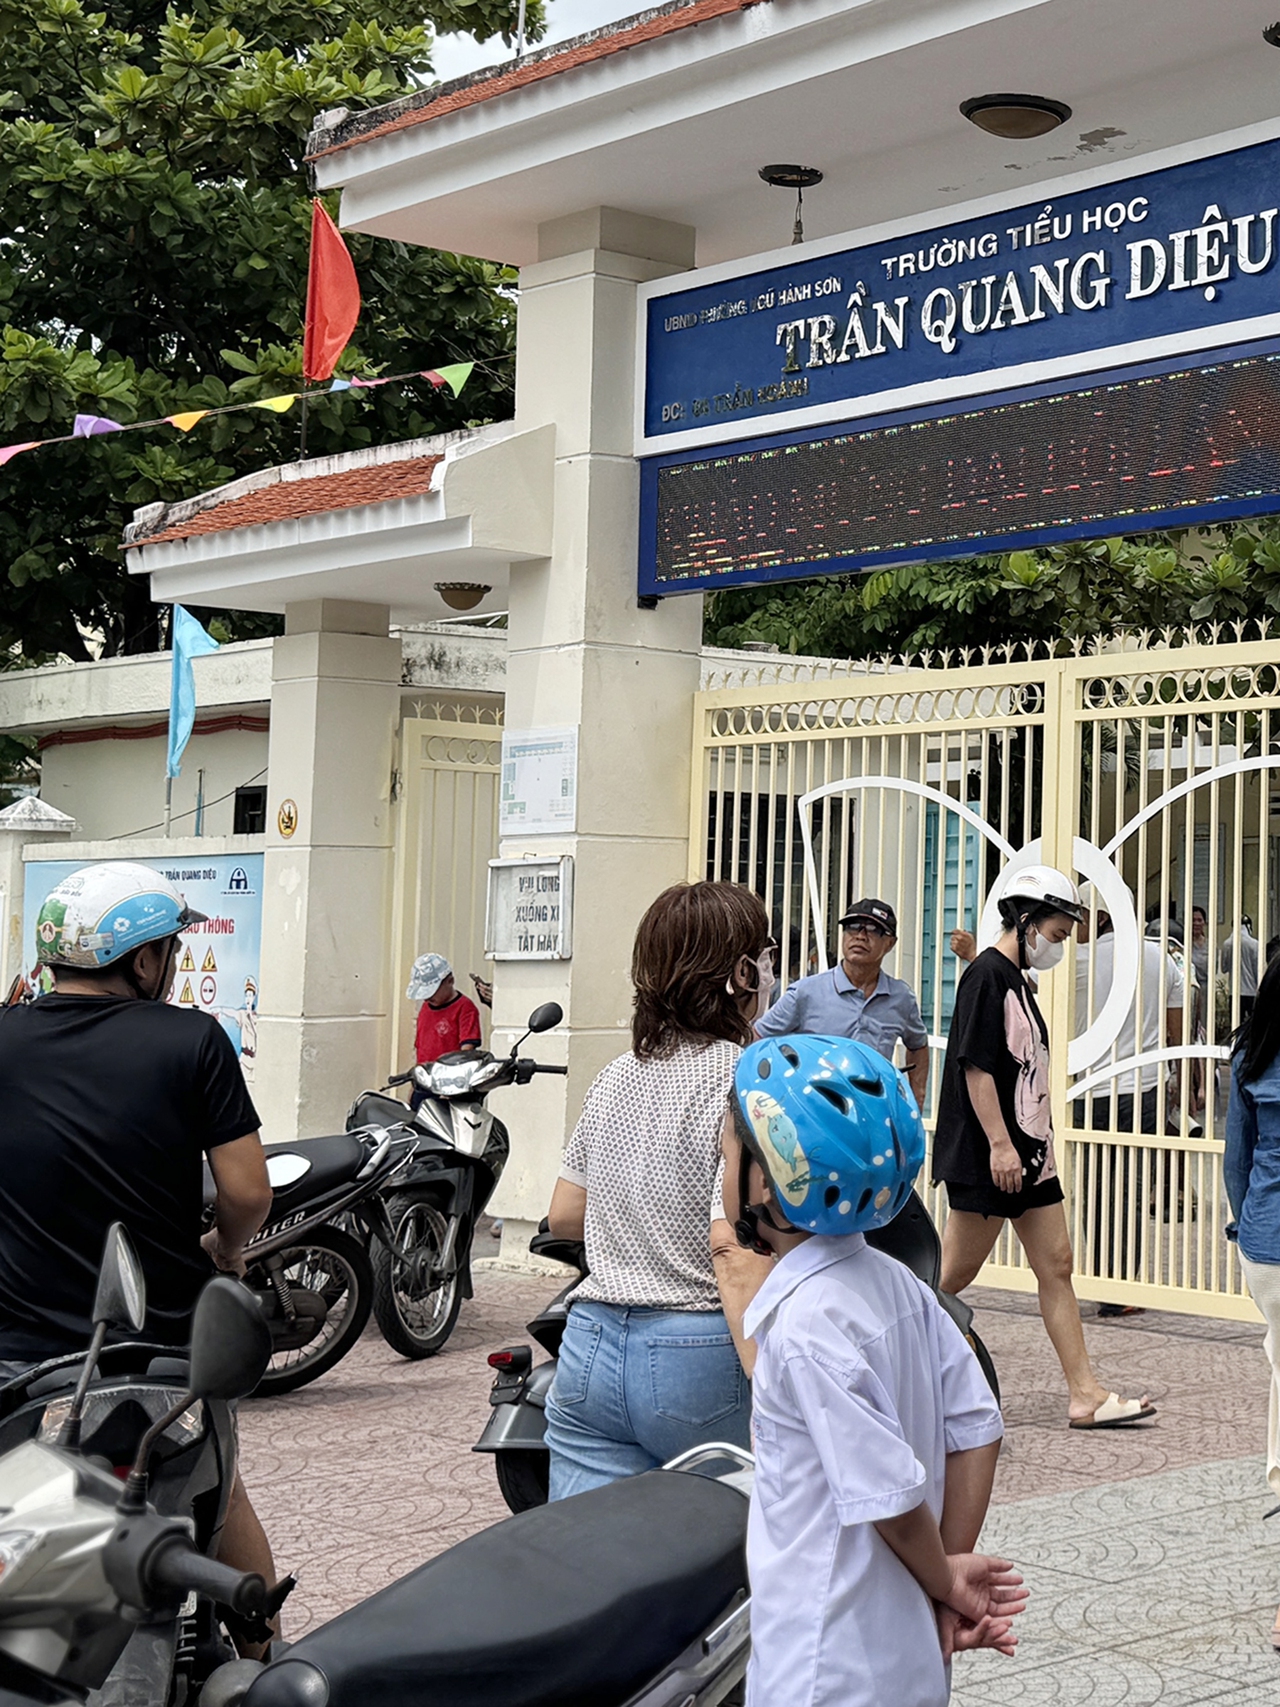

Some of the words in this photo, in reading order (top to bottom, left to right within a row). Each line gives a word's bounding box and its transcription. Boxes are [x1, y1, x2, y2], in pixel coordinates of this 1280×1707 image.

[881, 233, 998, 280] TRƯỜNG
[1006, 205, 1072, 250] TIỂU
[1082, 197, 1149, 233] HỌC
[664, 313, 698, 332] UBND
[778, 283, 812, 306] HÀNH
[814, 276, 842, 298] SƠN
[776, 281, 909, 373] TRẦN
[921, 250, 1111, 354] QUANG
[1125, 204, 1279, 301] DIỆU
[203, 915, 235, 934] THÔNG
[515, 899, 548, 922] XUỐNG
